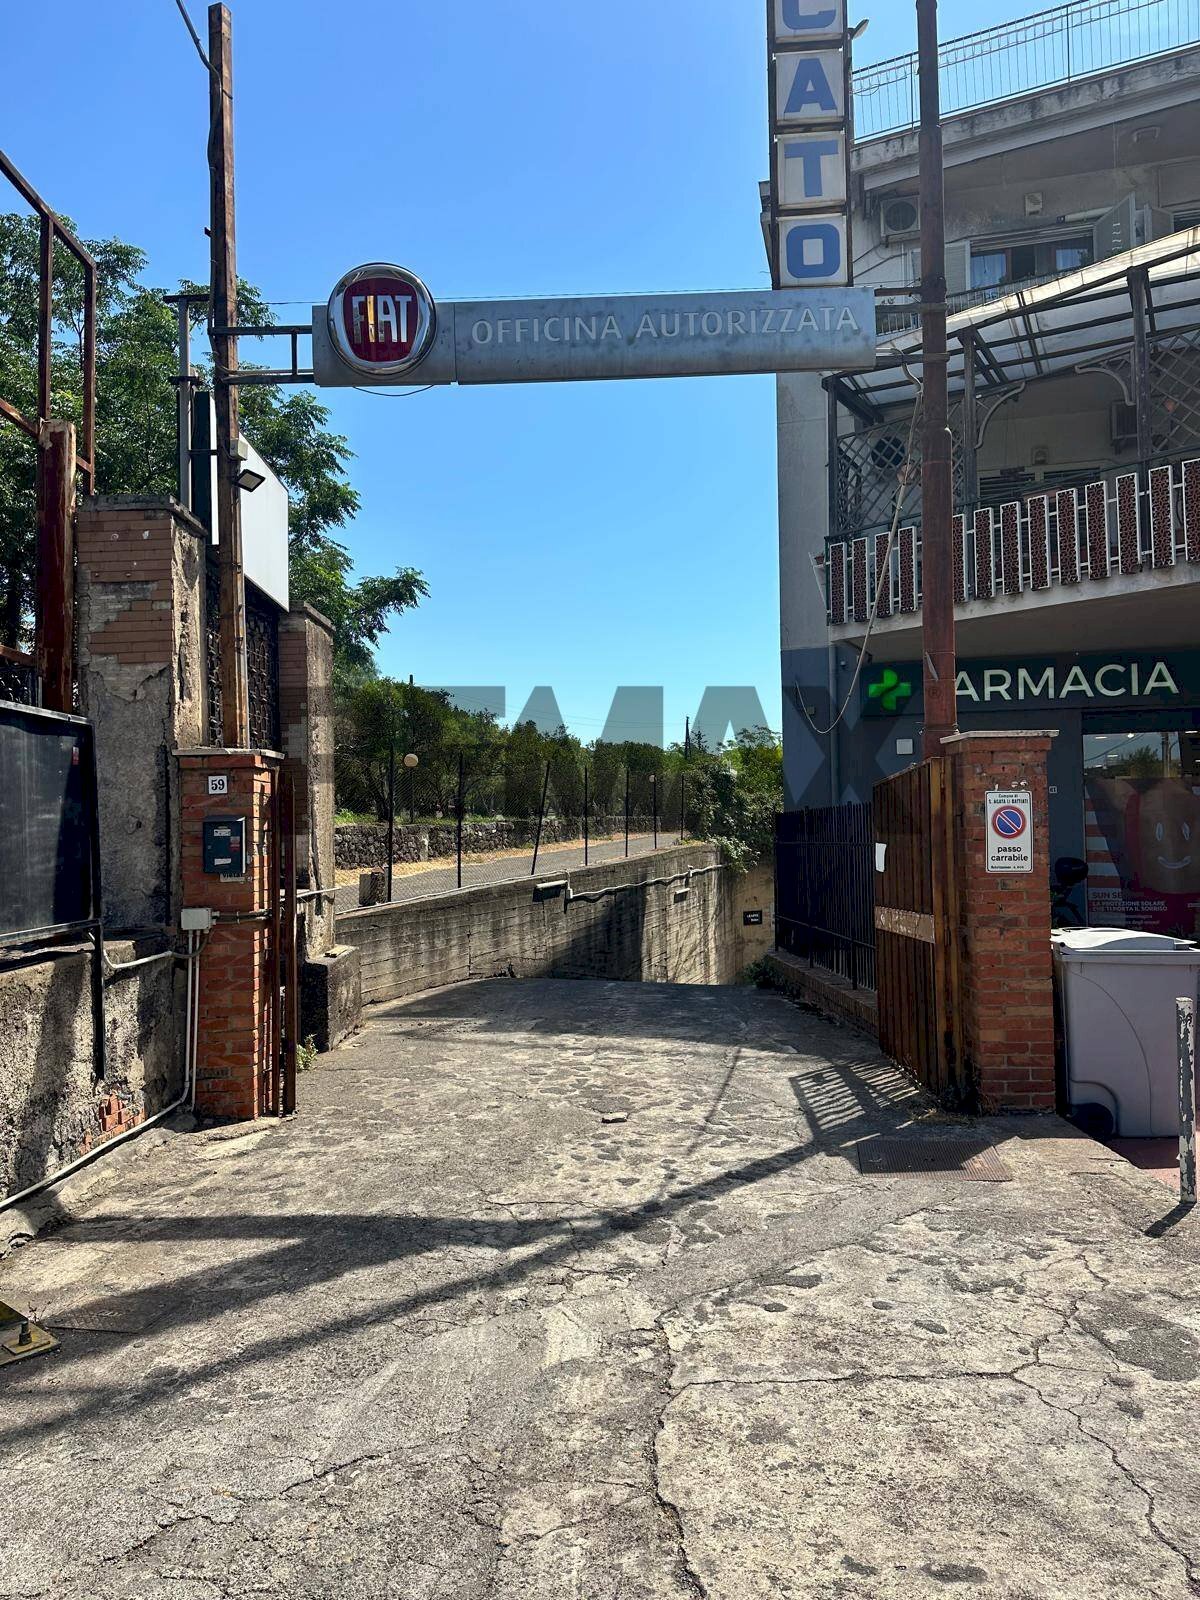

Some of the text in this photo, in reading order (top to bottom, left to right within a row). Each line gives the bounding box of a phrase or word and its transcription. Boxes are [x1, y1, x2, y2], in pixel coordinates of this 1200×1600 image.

[351, 294, 413, 345] FIAT
[471, 306, 860, 344] OFFICINA AUTORIZZATA
[955, 661, 1180, 702] ARMACIA
[211, 779, 225, 791] 59
[1092, 891, 1110, 899] SUN
